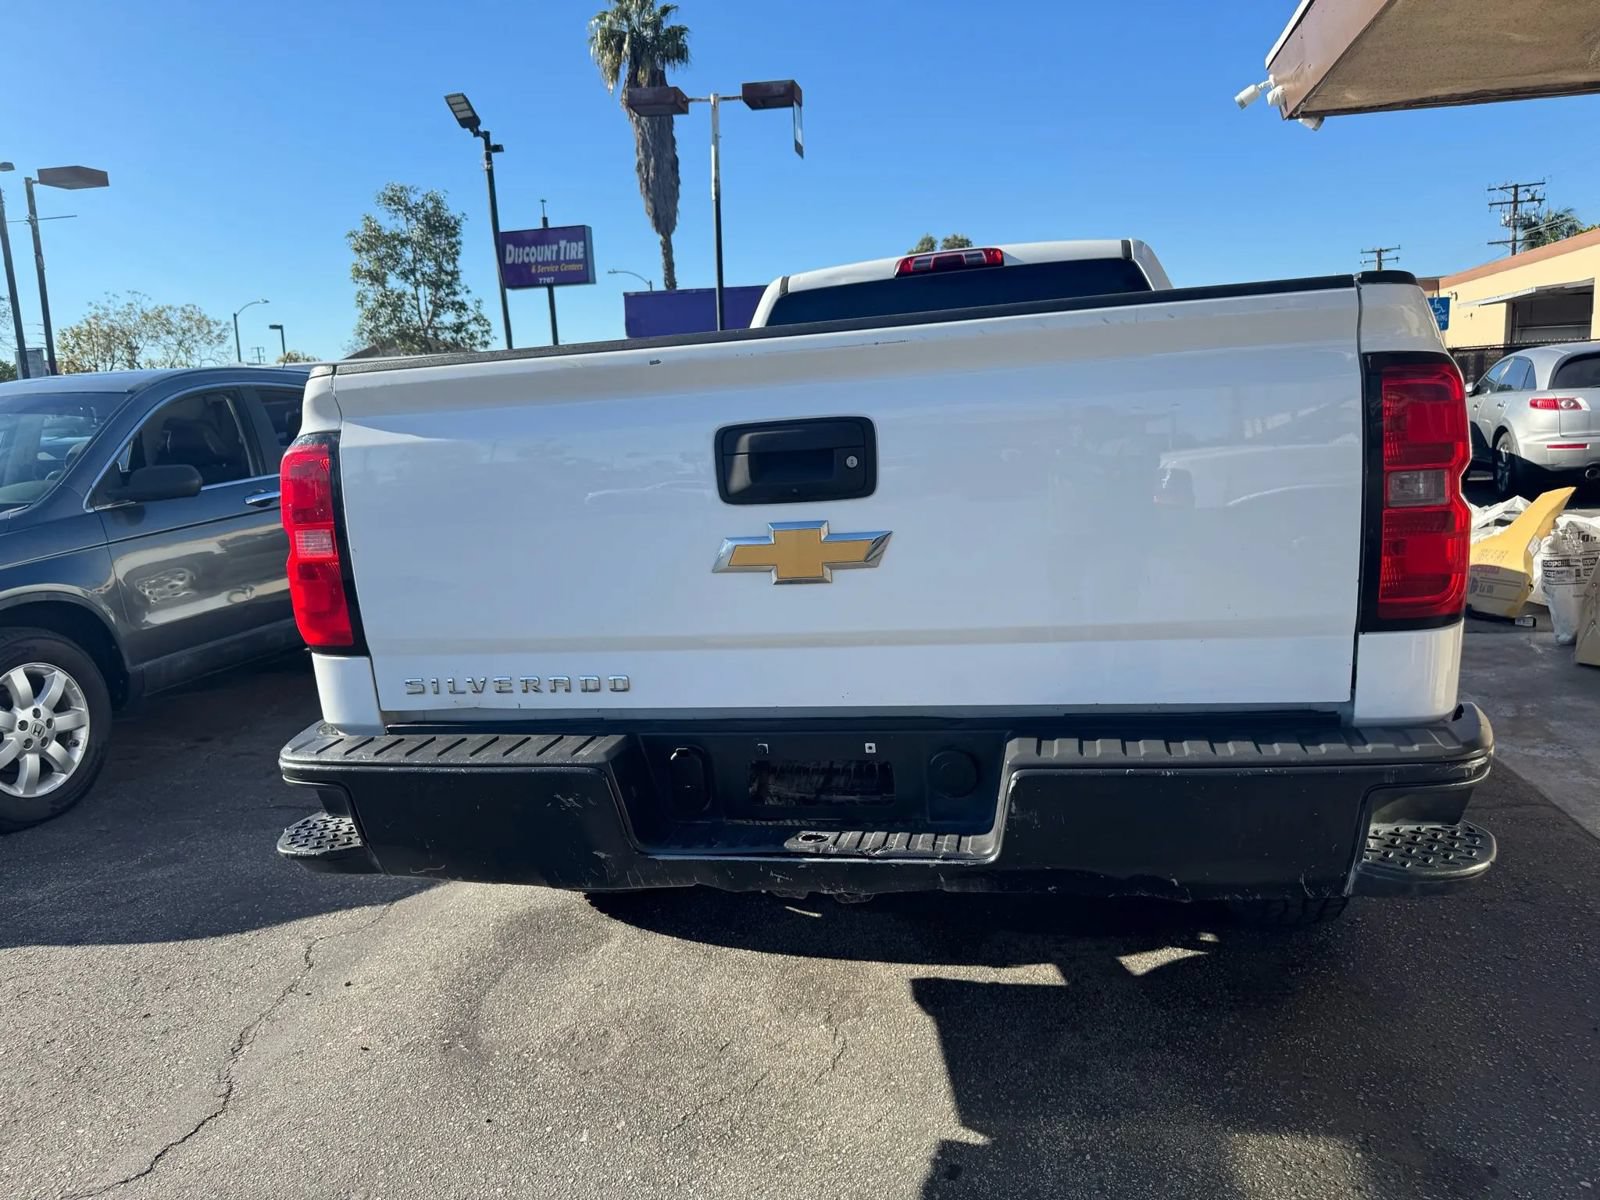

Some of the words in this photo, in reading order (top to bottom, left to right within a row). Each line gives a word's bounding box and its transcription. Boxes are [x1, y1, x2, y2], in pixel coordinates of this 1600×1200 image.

[505, 244, 558, 264] DISCOUNT
[559, 240, 584, 260] TIRE
[537, 264, 559, 273] Service
[404, 675, 631, 695] SILVERADO
